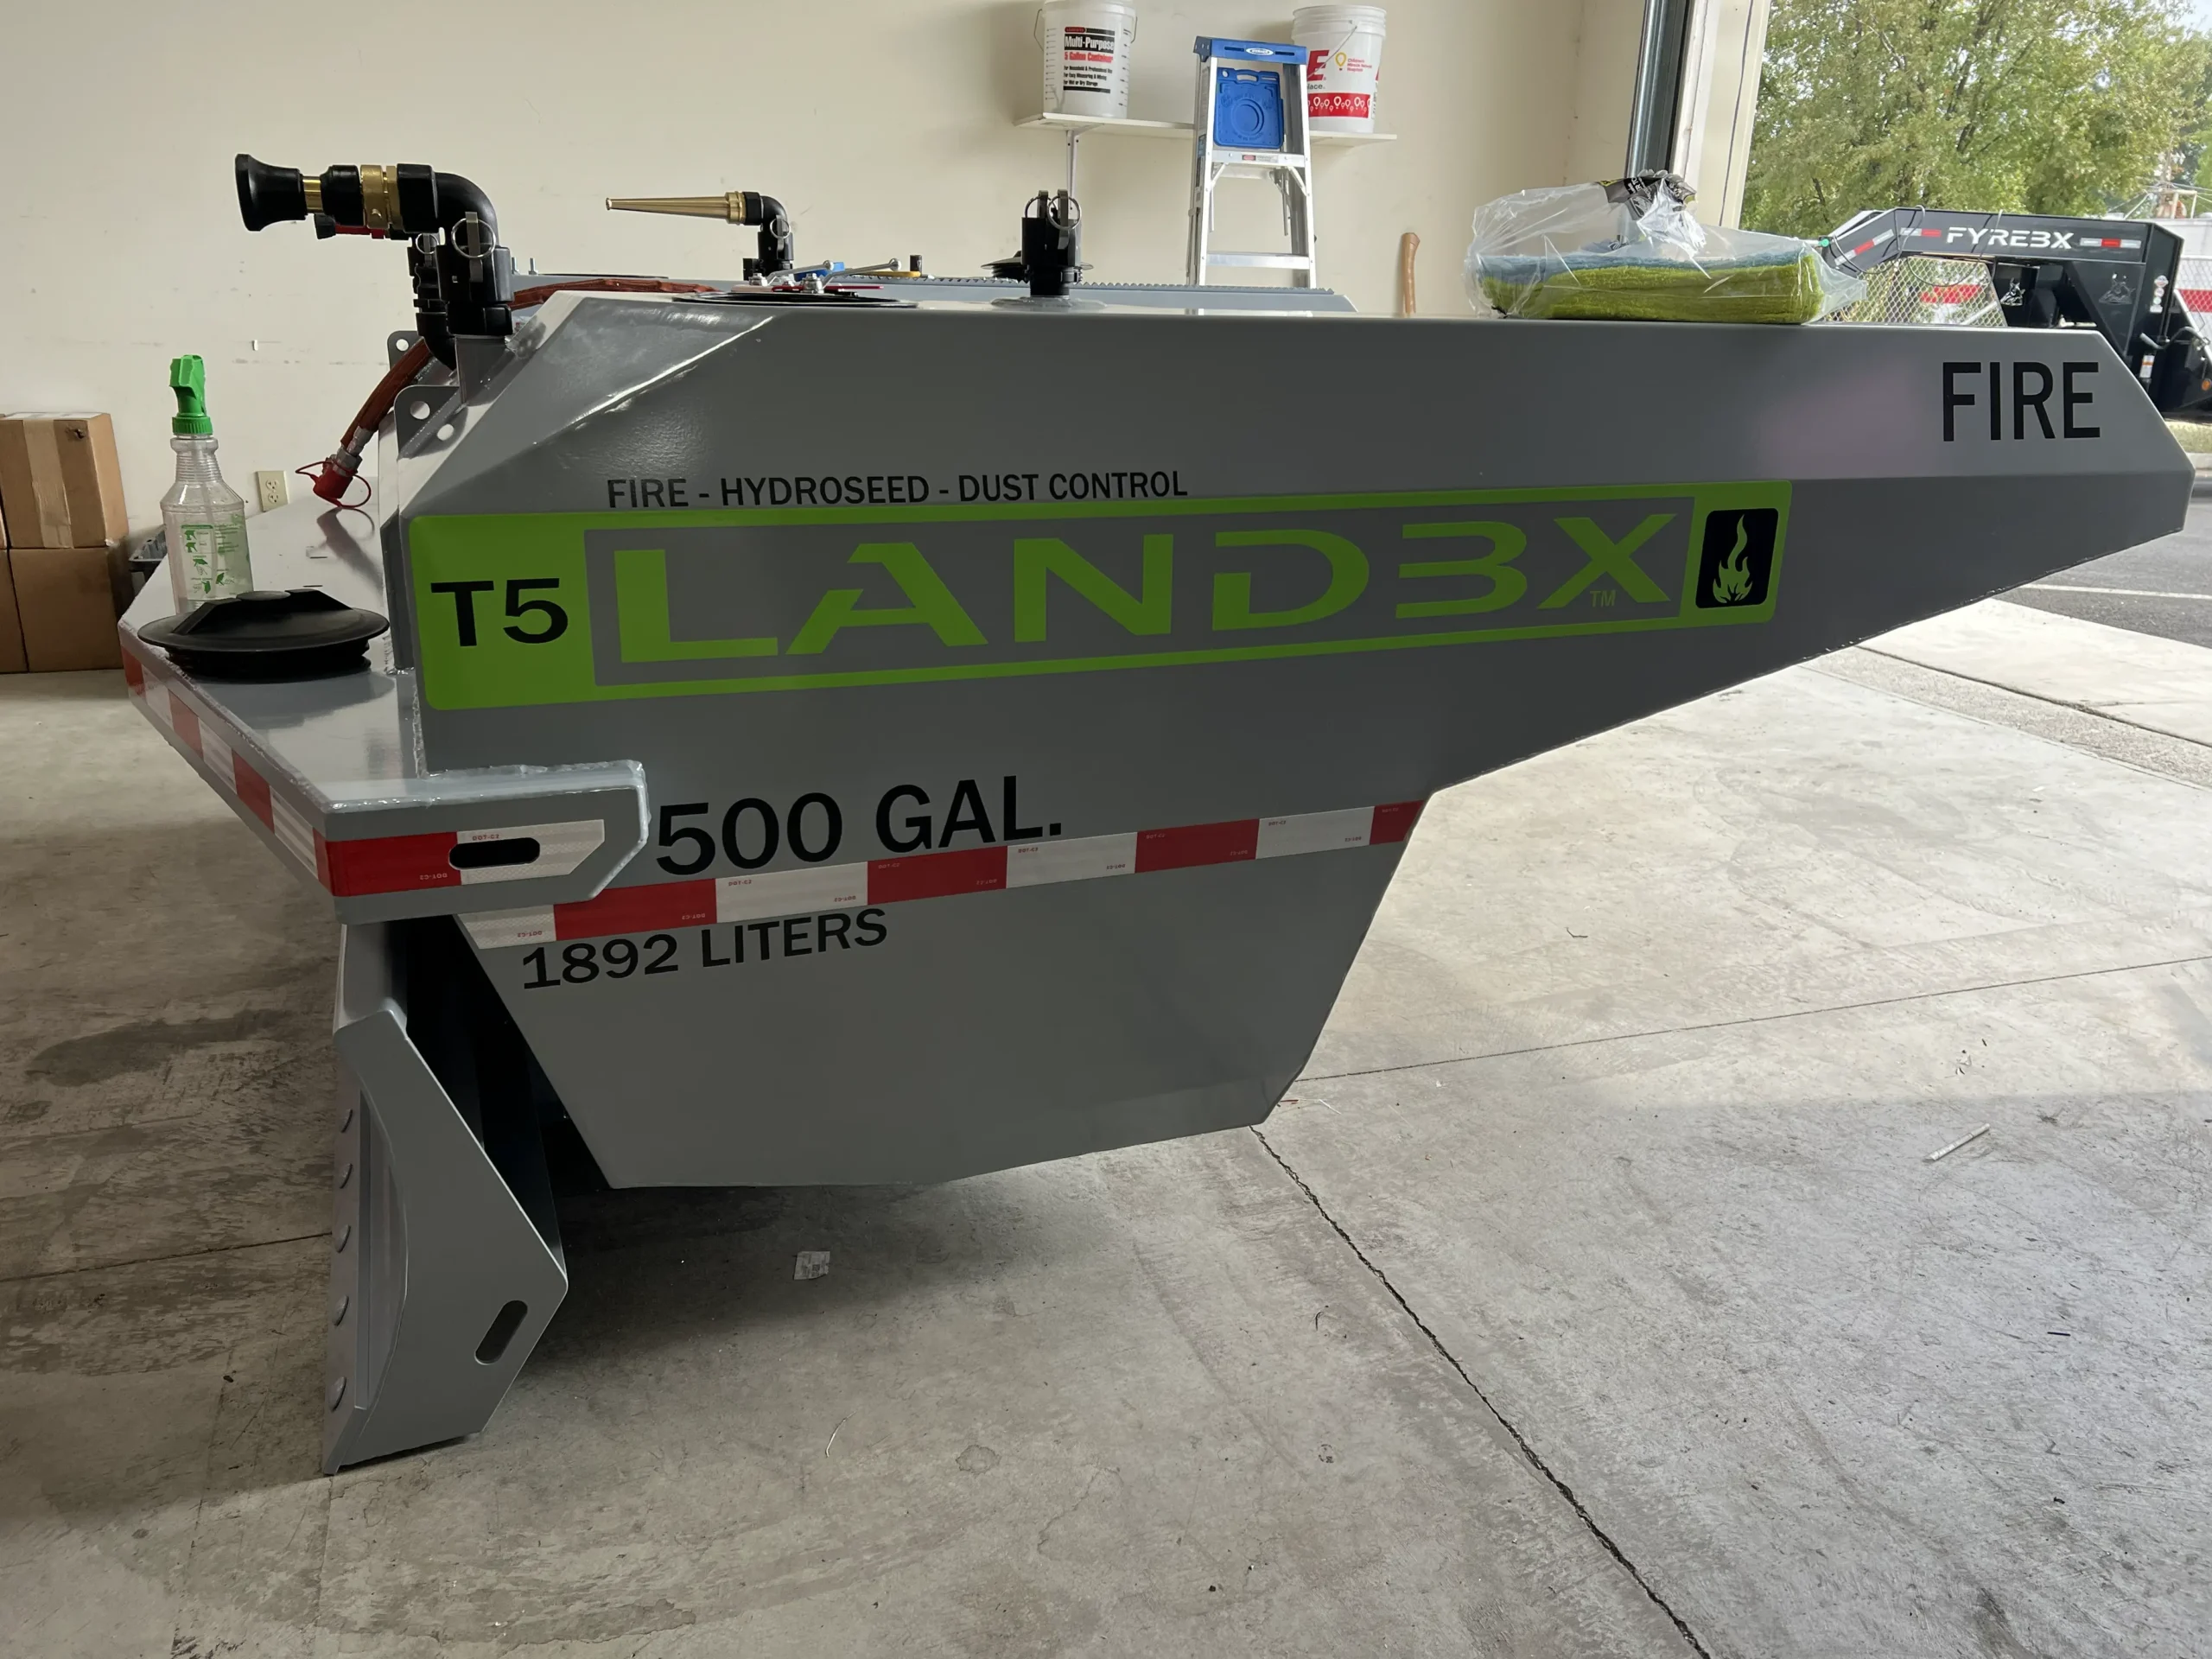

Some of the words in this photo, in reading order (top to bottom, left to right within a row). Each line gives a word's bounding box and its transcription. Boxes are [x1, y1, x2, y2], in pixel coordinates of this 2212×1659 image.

[1065, 35, 1115, 51] Multi-Purpose
[1942, 361, 2101, 442] FIRE
[607, 478, 690, 509] FIRE
[721, 475, 931, 506] HYDROSEED
[959, 473, 1039, 503] DUST
[1049, 471, 1189, 501] CONTROL
[430, 577, 569, 648] T5
[1589, 589, 1617, 607] TM
[656, 792, 843, 876] 500
[875, 775, 1062, 854] GAL.
[728, 879, 753, 887] DOT-C2
[522, 933, 680, 990] 1892
[701, 907, 889, 968] LITERS
